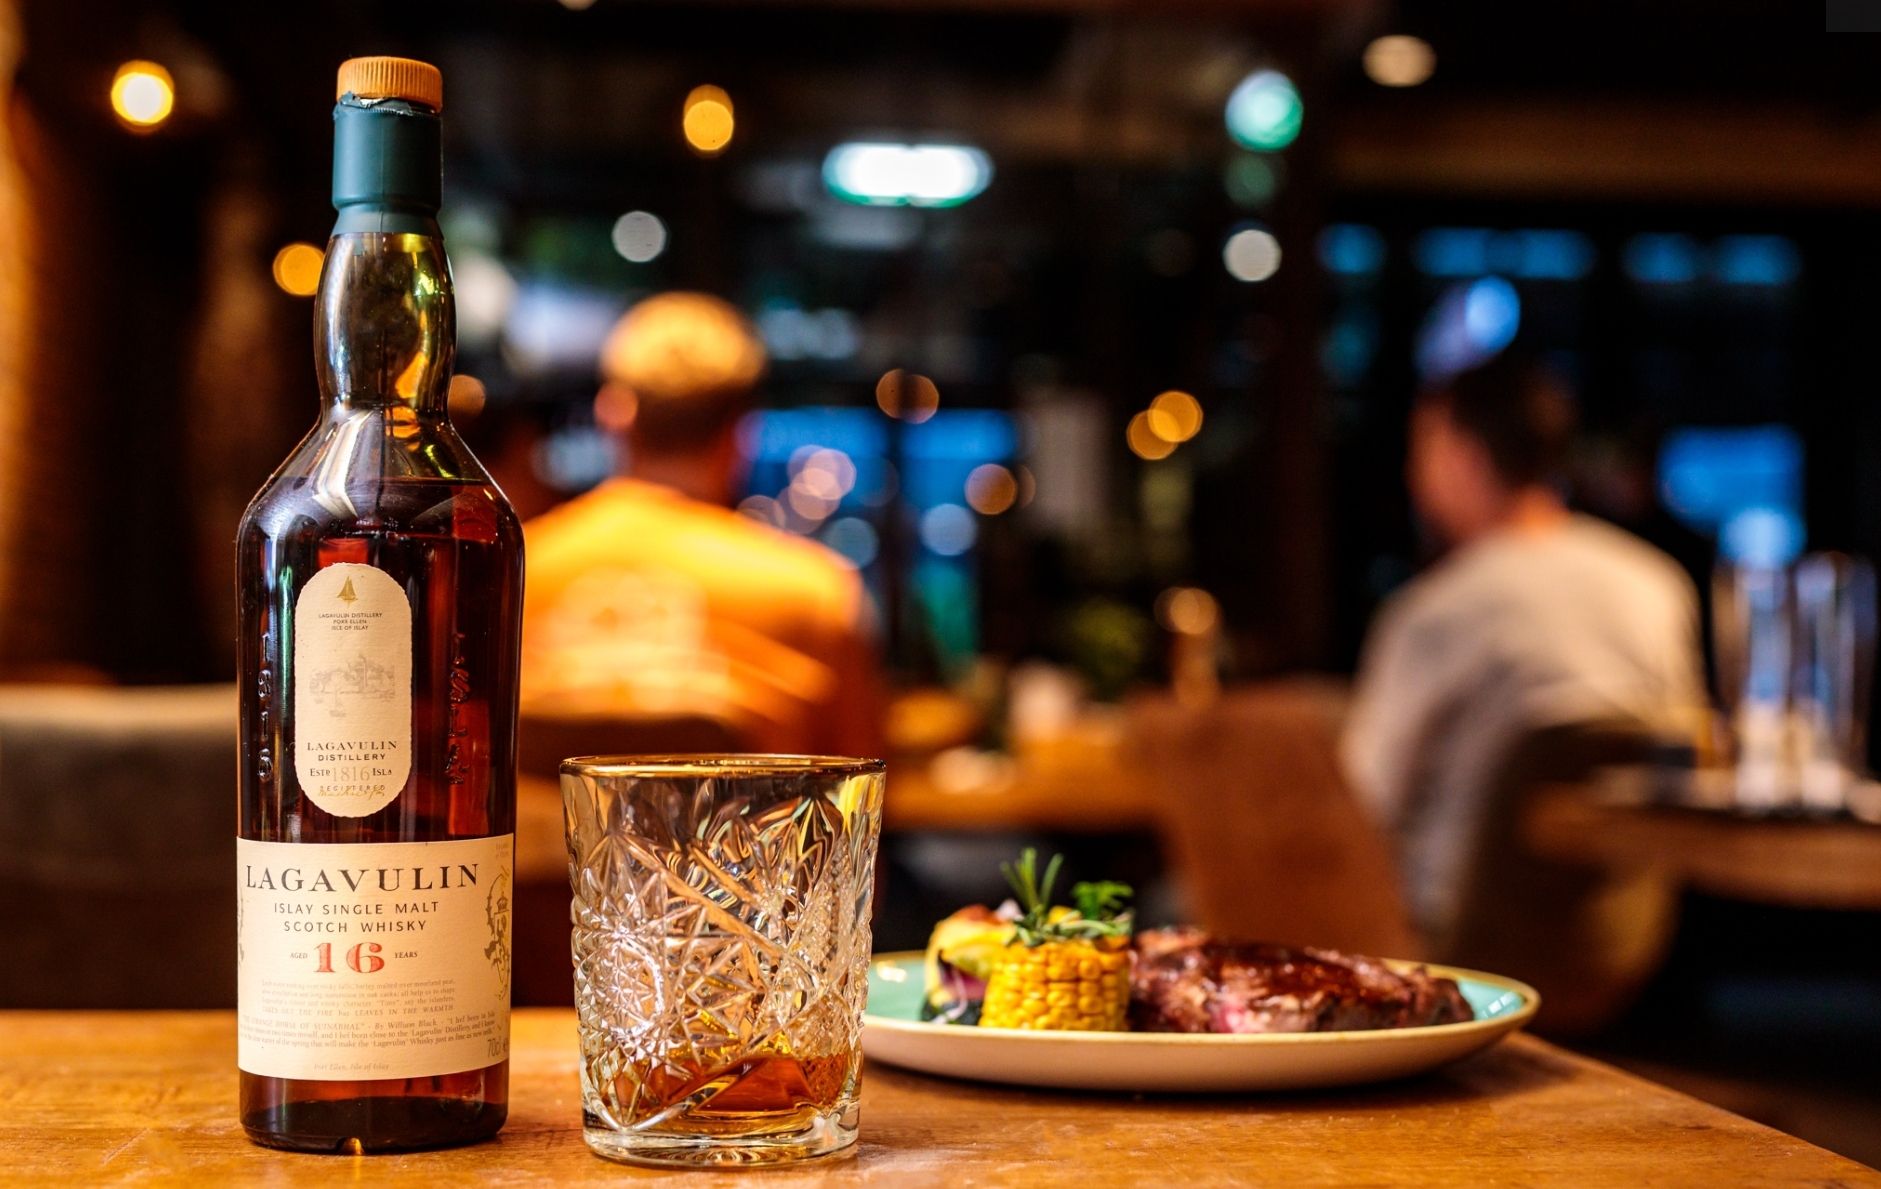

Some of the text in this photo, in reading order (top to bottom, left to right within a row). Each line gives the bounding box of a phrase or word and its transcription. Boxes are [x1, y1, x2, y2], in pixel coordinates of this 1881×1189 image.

[351, 611, 383, 619] DISTILLERY
[307, 740, 398, 752] LAGAVULIN
[317, 753, 386, 762] DISTILLERY
[333, 766, 370, 782] 1816
[246, 863, 479, 892] LAGAVULIN
[274, 901, 439, 916] ISLAY SINGLE MALT
[284, 920, 427, 933] SCOTCH WHISKY
[290, 941, 418, 974] AGED 16 YEARS
